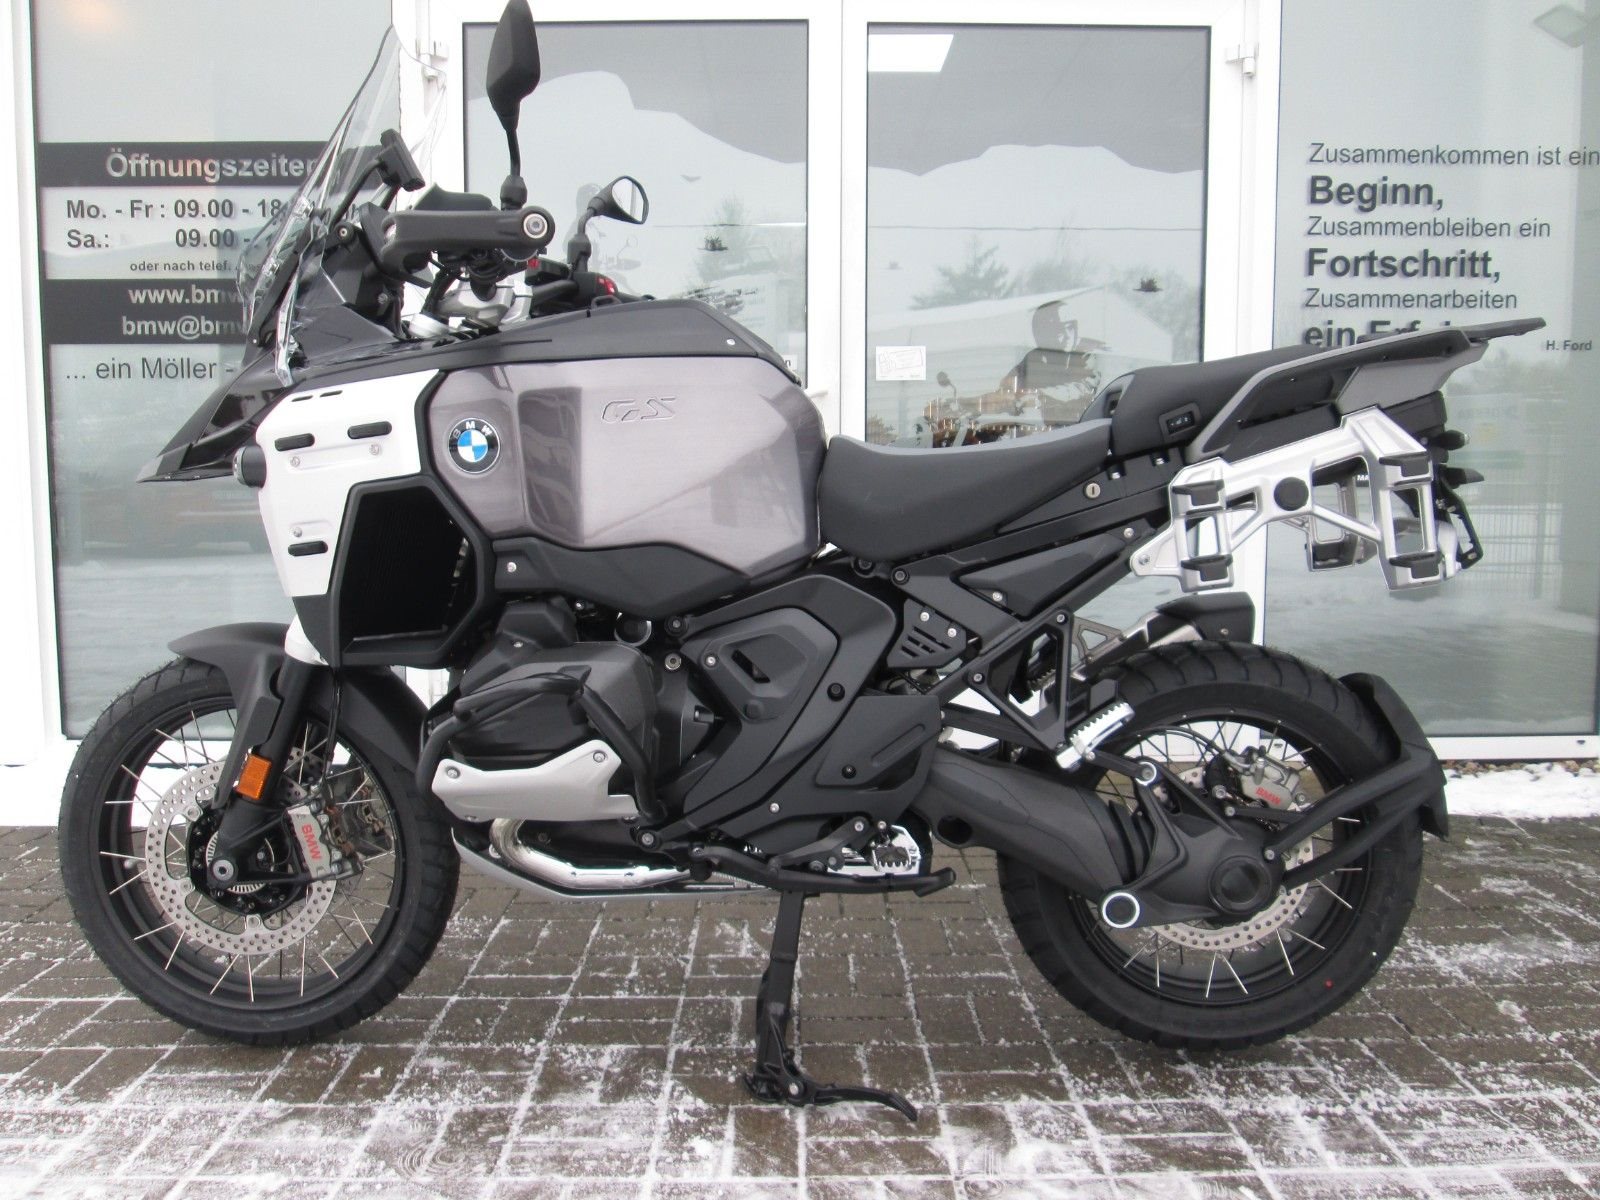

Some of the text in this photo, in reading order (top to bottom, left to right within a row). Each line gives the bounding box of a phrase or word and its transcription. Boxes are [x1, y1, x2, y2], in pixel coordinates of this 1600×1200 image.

[1309, 143, 1600, 166] Zusammenkommen ist ein
[1310, 175, 1443, 212] Beginn,
[67, 200, 107, 218] Mo.
[174, 199, 234, 218] 09.00
[1307, 216, 1550, 237] Zusammenbleiben ein
[67, 229, 110, 248] Sa.:
[175, 228, 234, 248] 09.00
[130, 260, 159, 271] oder
[163, 260, 195, 271] nach
[199, 260, 231, 271] telef.
[1307, 248, 1500, 283] Fortschritt,
[128, 284, 243, 303] www.bmw
[1305, 288, 1517, 309] Zusammenarbeiten
[122, 315, 243, 340] bmw@bm
[1304, 320, 1355, 346] ein
[1546, 340, 1592, 351] H. Ford
[96, 358, 132, 379] ein
[141, 357, 217, 379] Möller
[453, 420, 493, 440] BMW
[302, 824, 322, 859] BMW
